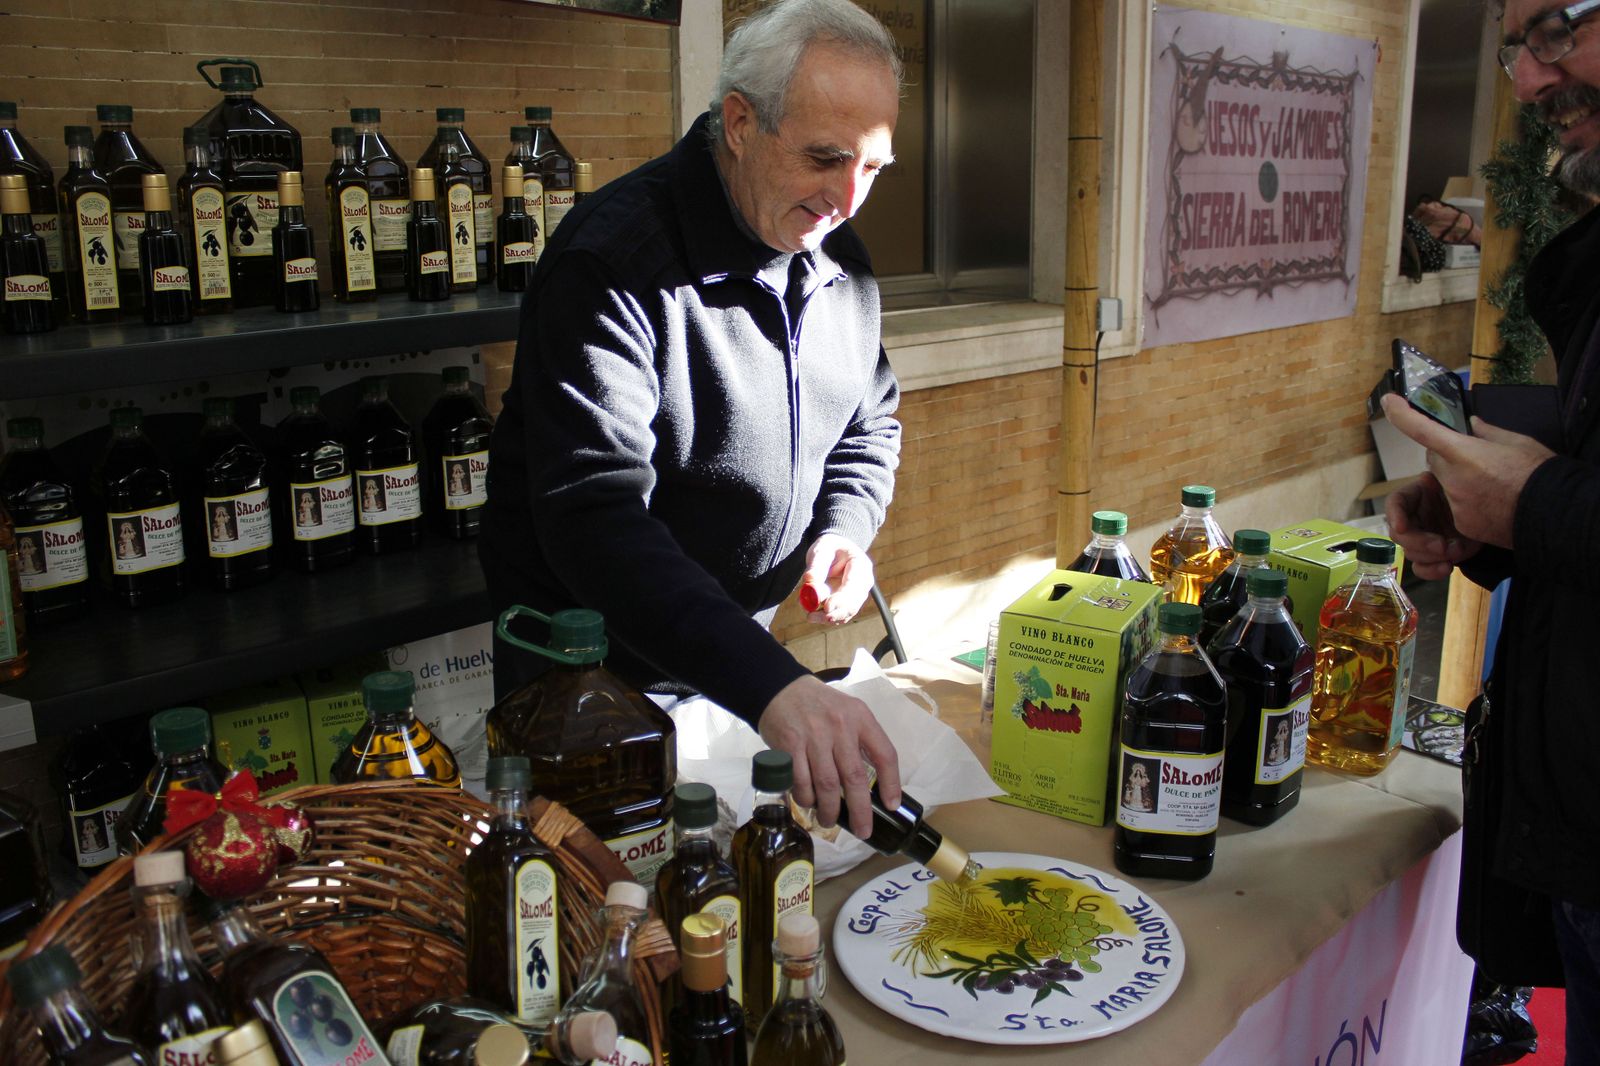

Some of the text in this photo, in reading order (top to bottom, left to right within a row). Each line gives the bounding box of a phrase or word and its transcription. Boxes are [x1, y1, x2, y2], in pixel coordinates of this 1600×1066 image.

[1272, 106, 1343, 160] JAMONES
[257, 195, 279, 210] SAL
[549, 194, 575, 205] SALOM
[196, 207, 222, 220] SALOME
[344, 204, 367, 217] SALOME
[379, 203, 412, 216] SALOM
[80, 213, 109, 226] SALOME
[1181, 190, 1342, 250] SIERRA DEL ROMERO
[287, 263, 318, 275] SALOM
[423, 257, 449, 267] SALOM
[156, 271, 190, 283] SALOM
[7, 280, 49, 292] SALOME
[320, 487, 353, 502] SALOM
[237, 500, 270, 516] SALOM
[143, 513, 182, 532] SALOM
[45, 529, 86, 547] SALOM
[1021, 626, 1094, 649] VINO BLANCO
[1009, 641, 1105, 667] CONDADO DE HUELVA
[420, 649, 494, 679] de Huelv
[1076, 664, 1105, 674] ORIGEN
[449, 676, 459, 684] DE
[464, 670, 494, 681] GARAN
[1056, 683, 1070, 698] Sta.
[328, 700, 348, 710] VINO
[233, 711, 289, 728] VINO BLANCO
[321, 711, 355, 722] CONDADO
[1294, 710, 1310, 729] SALO
[998, 769, 1022, 781] LITROS
[1034, 773, 1056, 784] ABRIR
[1162, 760, 1223, 786] SALOME
[1164, 786, 1189, 798] DULCE
[614, 829, 666, 863] LOME
[778, 884, 810, 914] SALOME
[520, 895, 553, 919] SALOME
[848, 880, 912, 934] Coop. del
[1120, 896, 1173, 969] SALOME
[1090, 971, 1167, 1020] MARIA
